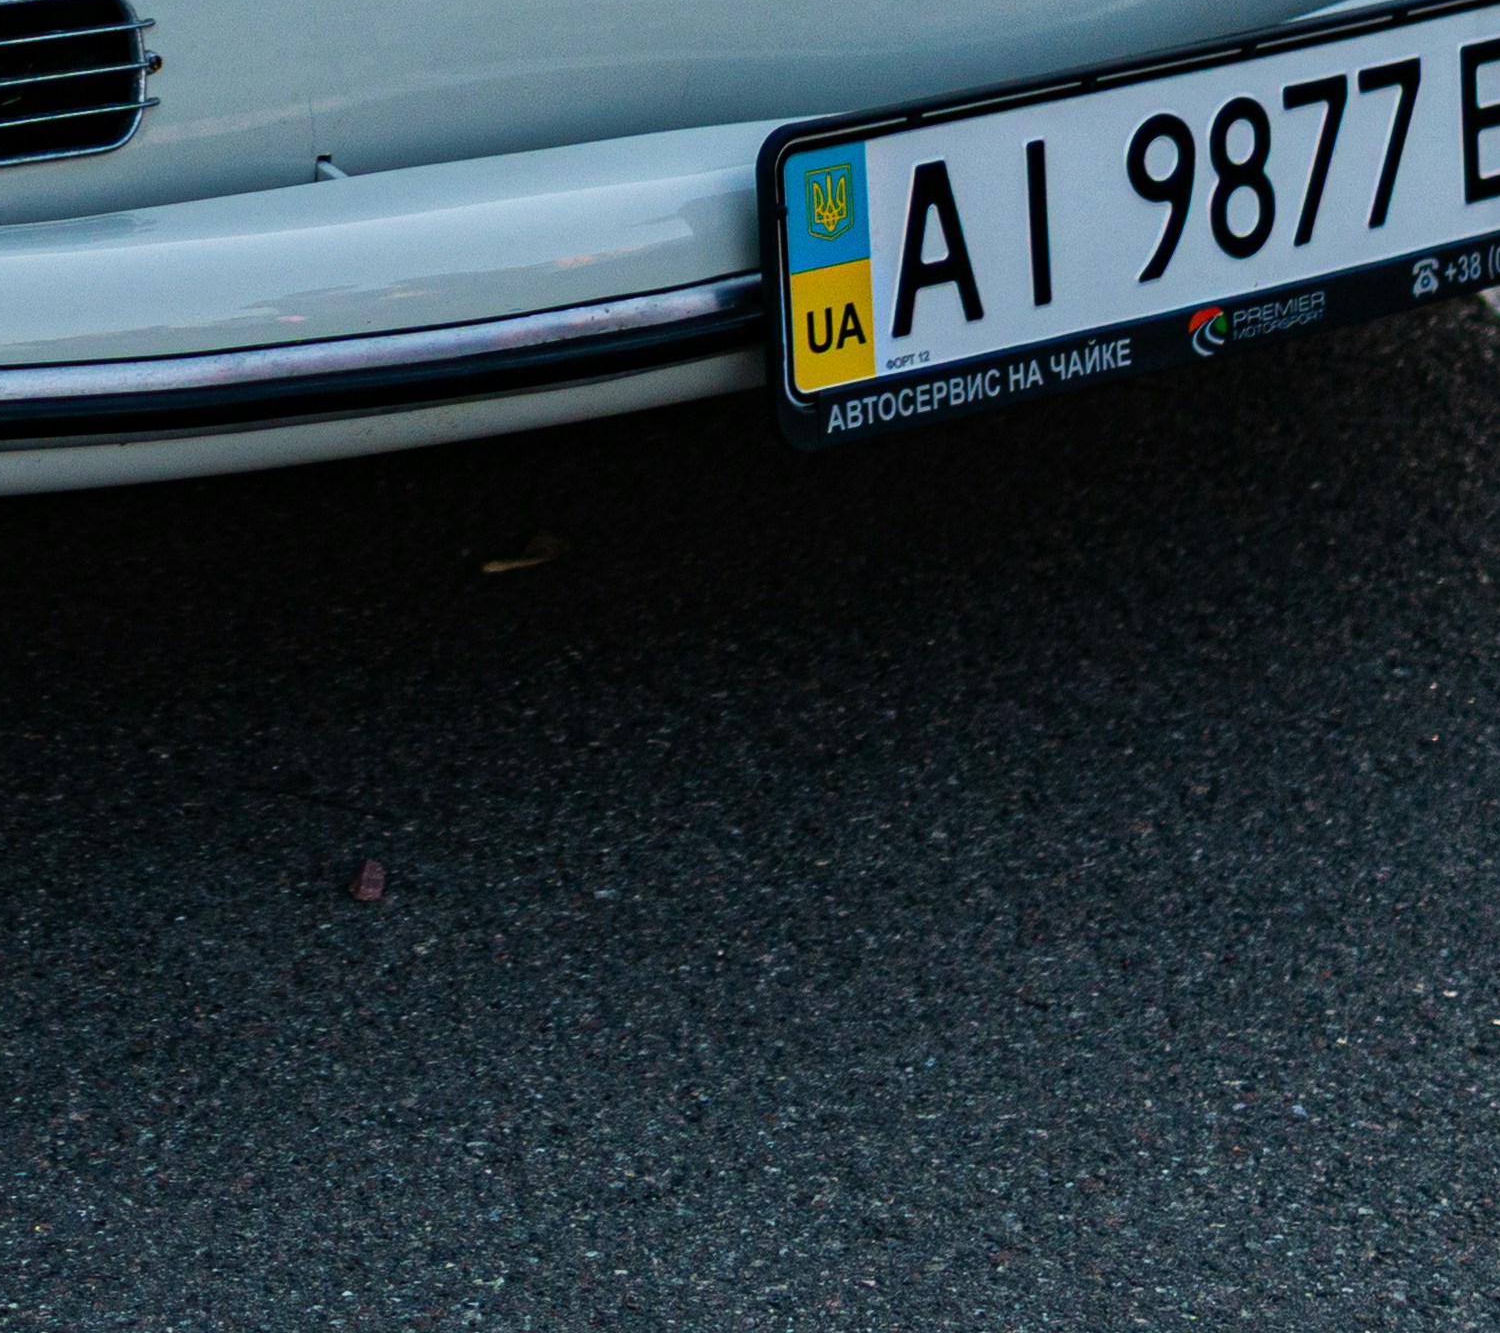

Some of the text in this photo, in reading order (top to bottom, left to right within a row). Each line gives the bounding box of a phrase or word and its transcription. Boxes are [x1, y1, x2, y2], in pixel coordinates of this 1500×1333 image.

[890, 138, 1053, 338] AI
[1125, 56, 1422, 283] 9877
[1444, 252, 1482, 283] +38
[806, 301, 867, 354] UA
[1232, 290, 1326, 328] PREMIER
[827, 338, 1132, 434] АВТОСЕРВИС НА ЧАЙКЕ
